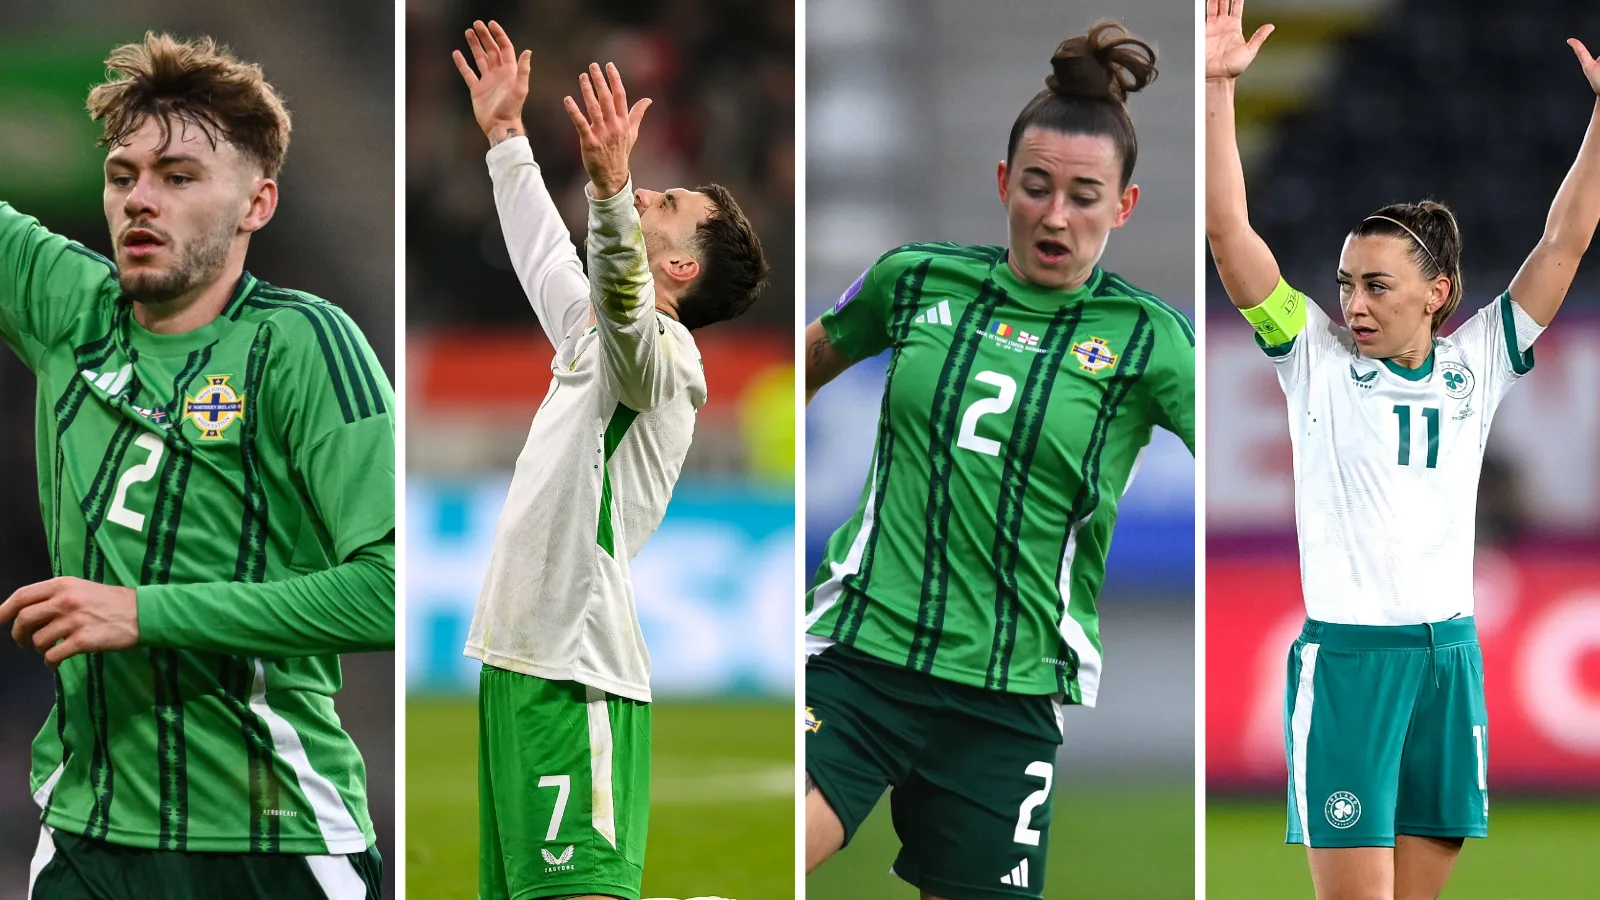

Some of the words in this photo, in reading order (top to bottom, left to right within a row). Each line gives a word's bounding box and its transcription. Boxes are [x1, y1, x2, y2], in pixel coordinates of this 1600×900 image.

[956, 370, 1017, 457] 2
[1393, 404, 1440, 468] 11
[106, 432, 165, 532] 2
[262, 809, 298, 817] AEROREADY
[538, 775, 571, 841] 7
[1013, 760, 1053, 846] 2
[544, 864, 575, 873] CASTORE
